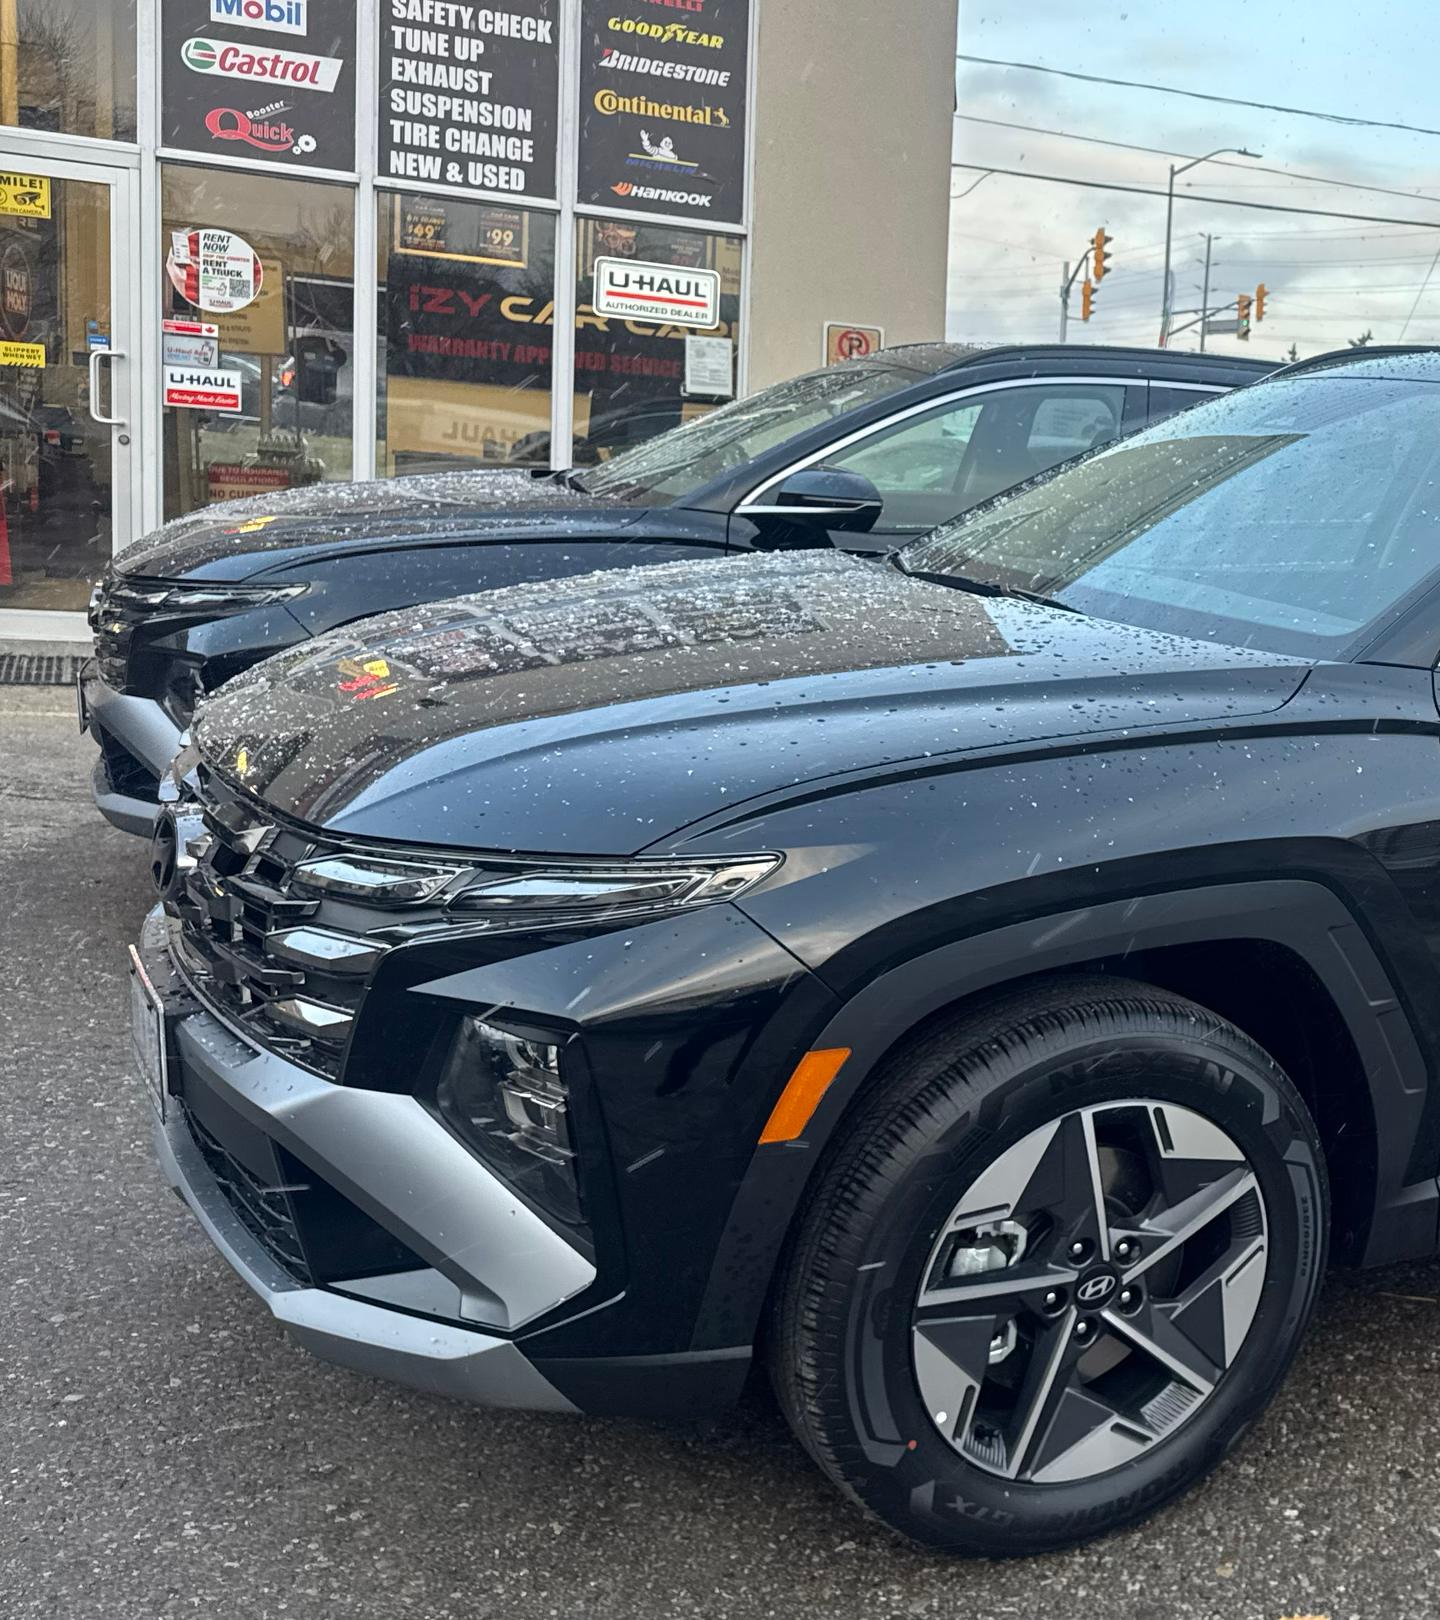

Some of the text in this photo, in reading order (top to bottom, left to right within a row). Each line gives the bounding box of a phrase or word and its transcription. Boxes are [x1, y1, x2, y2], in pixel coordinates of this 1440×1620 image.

[216, 0, 301, 26] Mobil
[392, 0, 552, 44] SAFETY CHECK
[391, 25, 484, 62] TUNE UP
[608, 17, 724, 49] GOODYEAR
[218, 47, 321, 85] Castrol
[391, 57, 492, 95] EXHAUST
[599, 48, 731, 87] BRIDGESTONE
[246, 100, 285, 119] Booster
[390, 88, 532, 132] SUSPENSION
[594, 88, 711, 126] Continental
[205, 107, 295, 152] Quick
[390, 119, 534, 162] TIRE CHANGE
[390, 150, 525, 191] NEW & USED
[624, 157, 697, 174] MICHELIN
[0, 175, 43, 190] MILE!
[203, 233, 232, 244] RENT
[203, 242, 229, 253] NOW
[203, 259, 227, 268] RENT
[212, 268, 243, 278] TRUCK
[609, 271, 706, 298] U-HAUL
[605, 301, 708, 324] AUTHORIZED DEALER
[408, 333, 512, 361] WARRANTY
[610, 353, 681, 378] SERVICE
[170, 373, 236, 388] U-HAUL
[209, 489, 226, 498] NO
